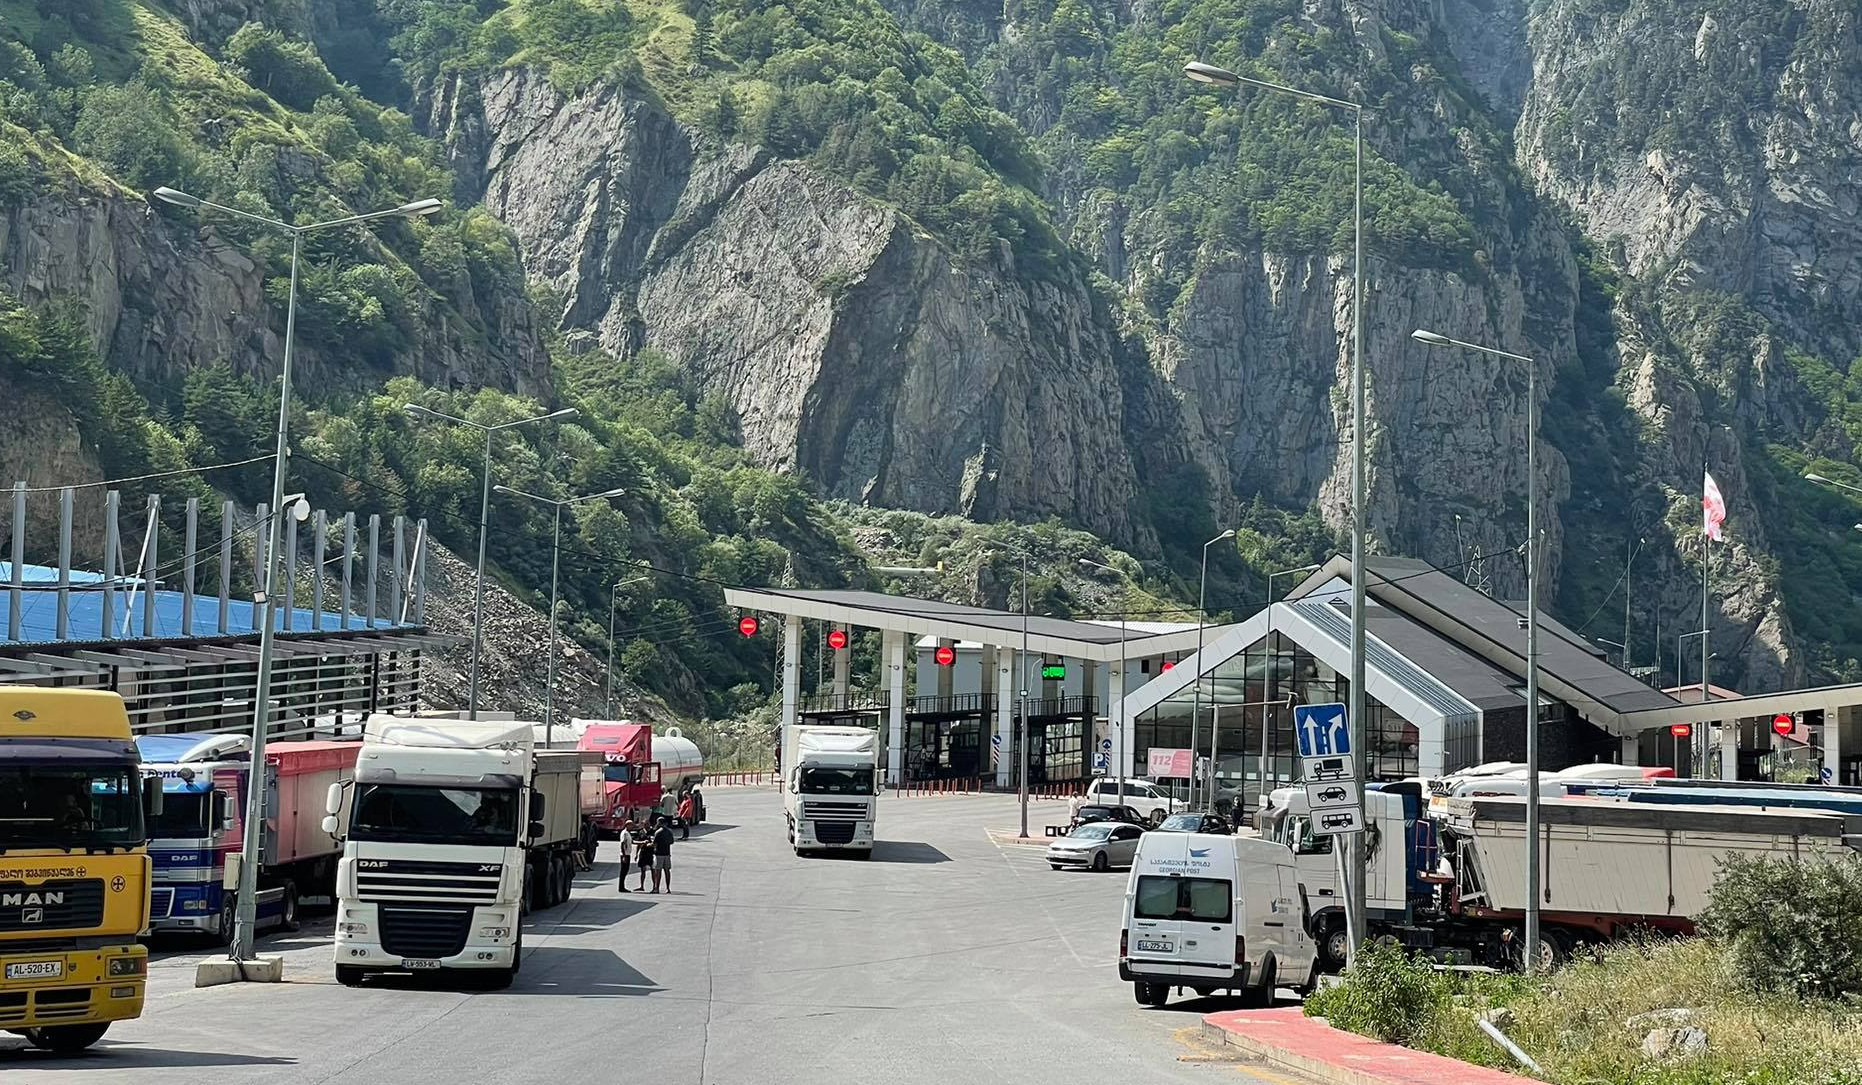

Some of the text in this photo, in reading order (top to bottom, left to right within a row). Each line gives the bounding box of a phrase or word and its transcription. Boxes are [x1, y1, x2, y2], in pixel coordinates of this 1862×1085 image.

[1094, 753, 1103, 767] P
[1152, 755, 1172, 766] 112
[359, 860, 389, 868] DAF
[2, 891, 64, 907] MAN
[14, 963, 56, 975] AL-520-EX
